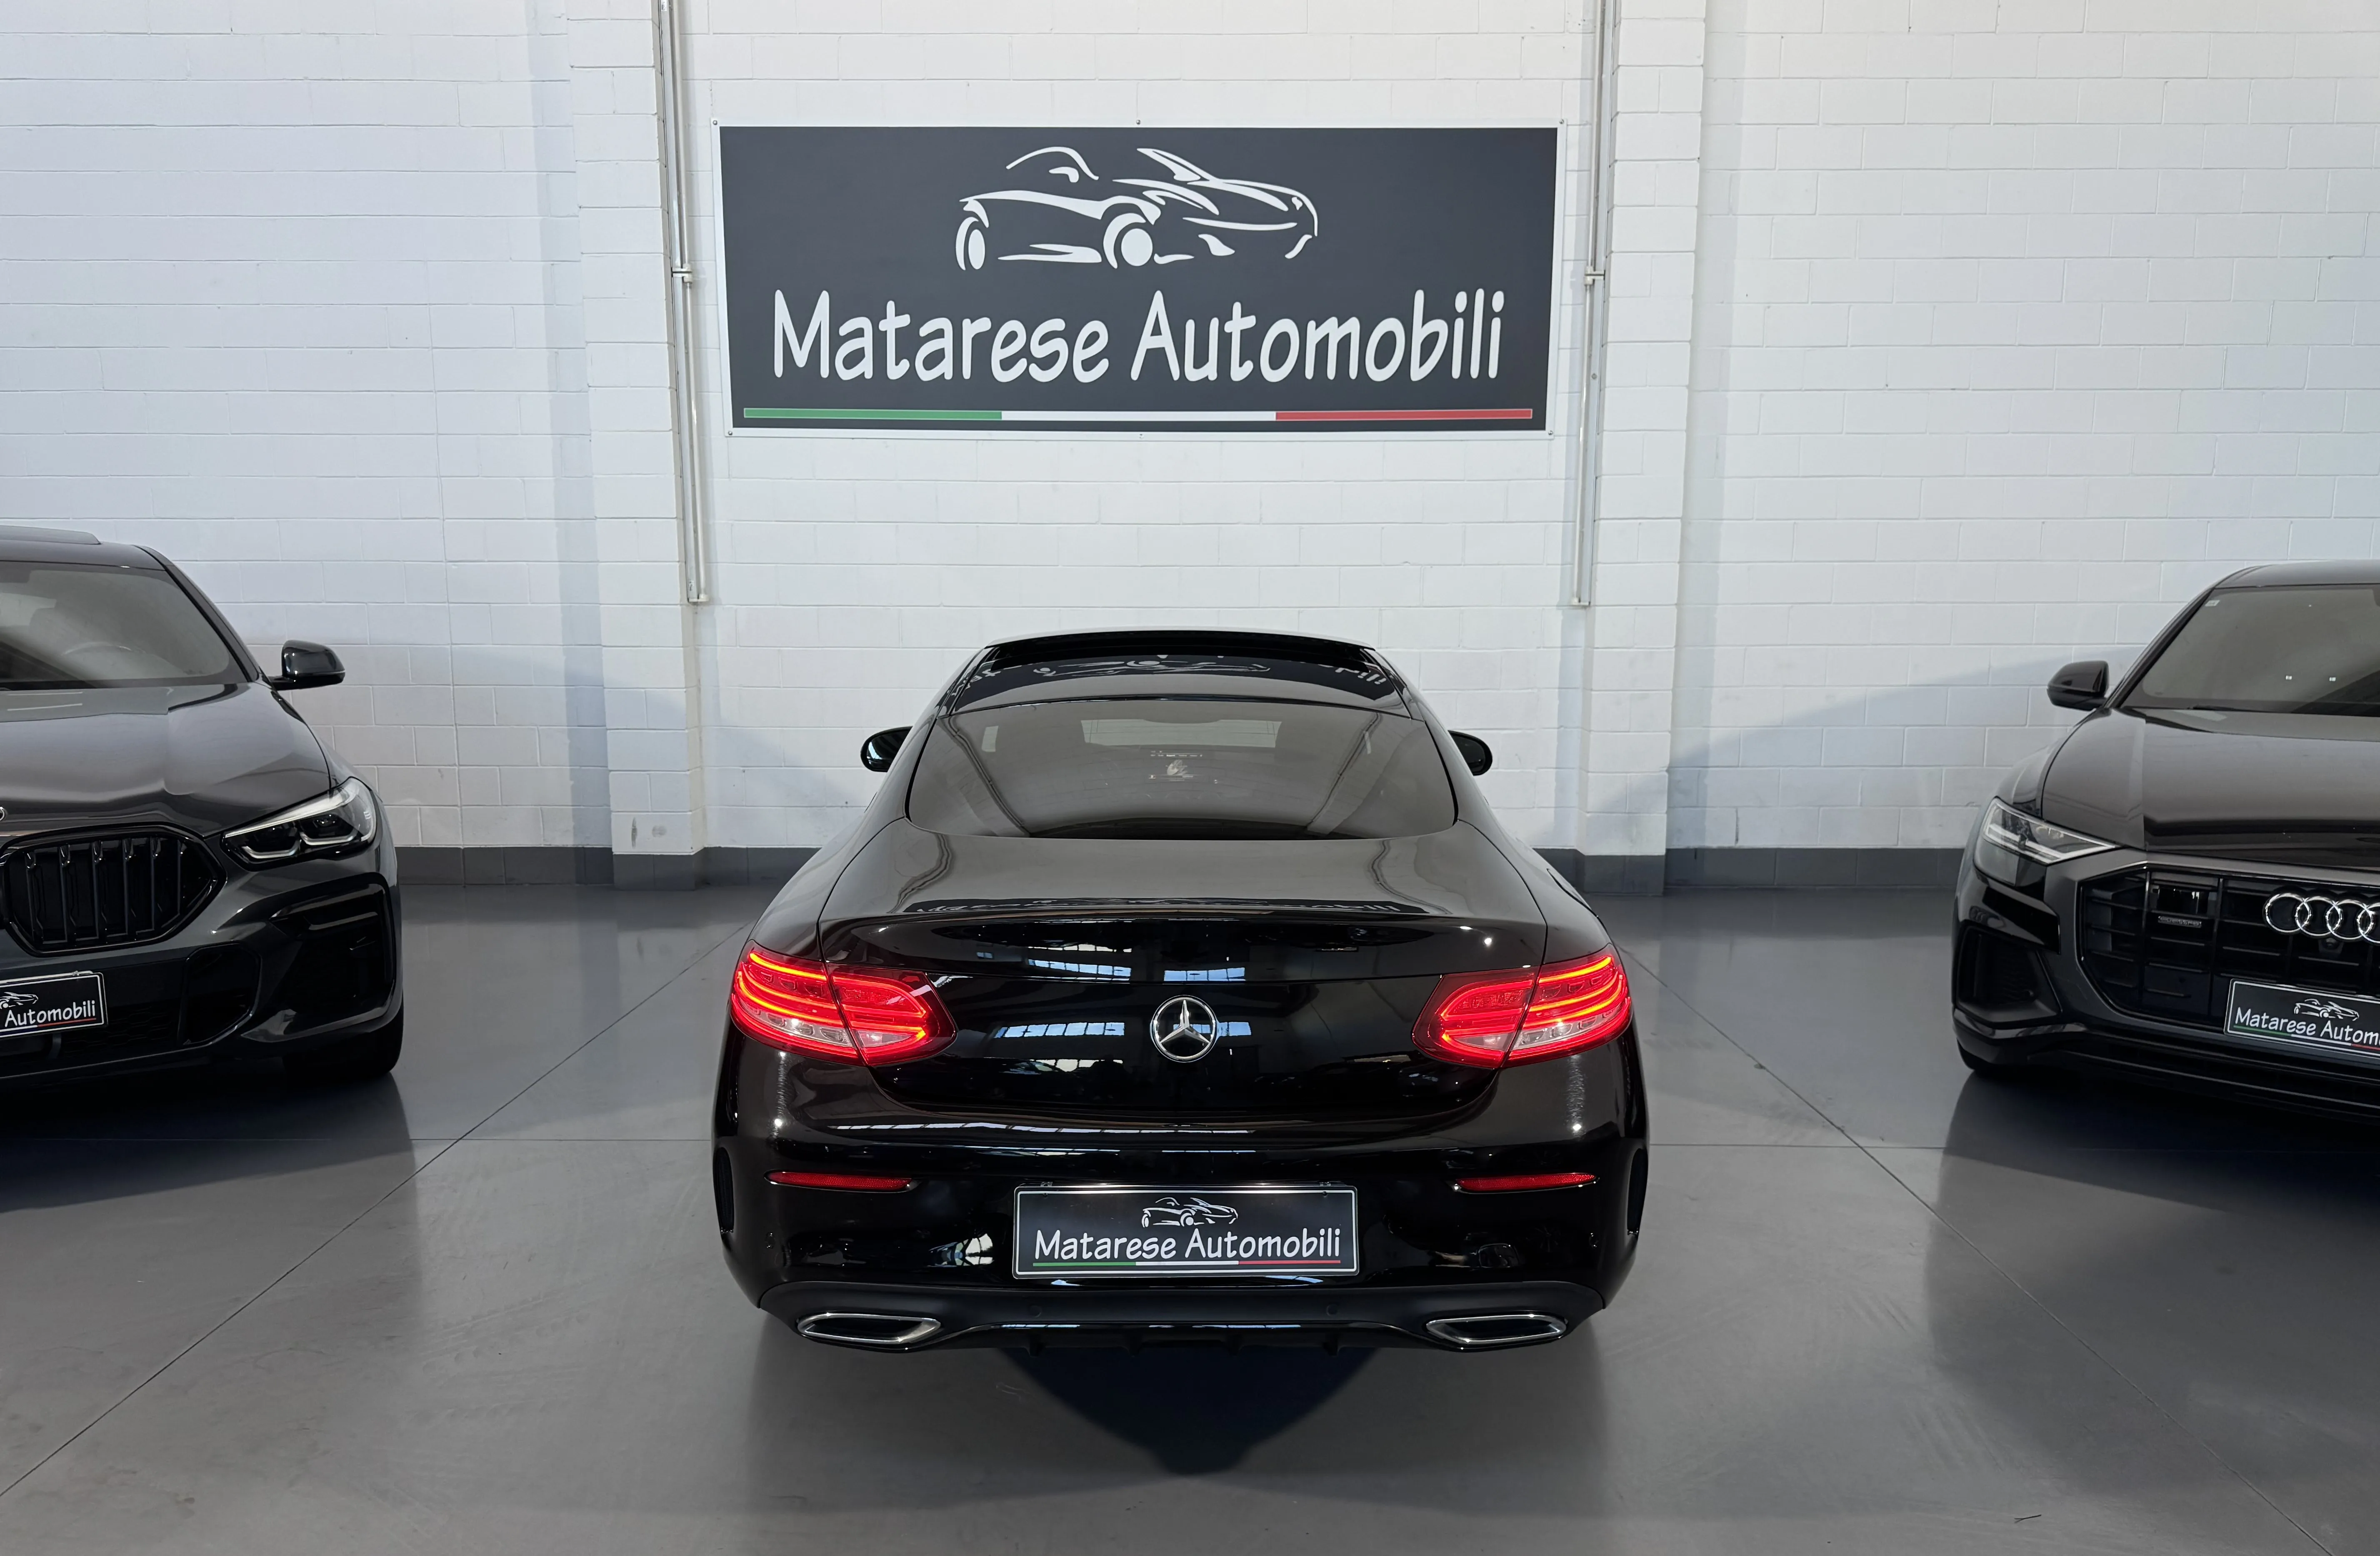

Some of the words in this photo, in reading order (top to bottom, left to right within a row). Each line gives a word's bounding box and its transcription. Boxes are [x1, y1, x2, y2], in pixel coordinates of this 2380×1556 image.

[774, 289, 1110, 383] Matarese
[1130, 288, 1505, 383] Automobili
[5, 1000, 95, 1027] Automobili
[2235, 1007, 2317, 1036] Matarese
[2320, 1020, 2380, 1046] Autom
[1035, 1229, 1177, 1260] Matarese
[1184, 1227, 1341, 1258] Automobili
